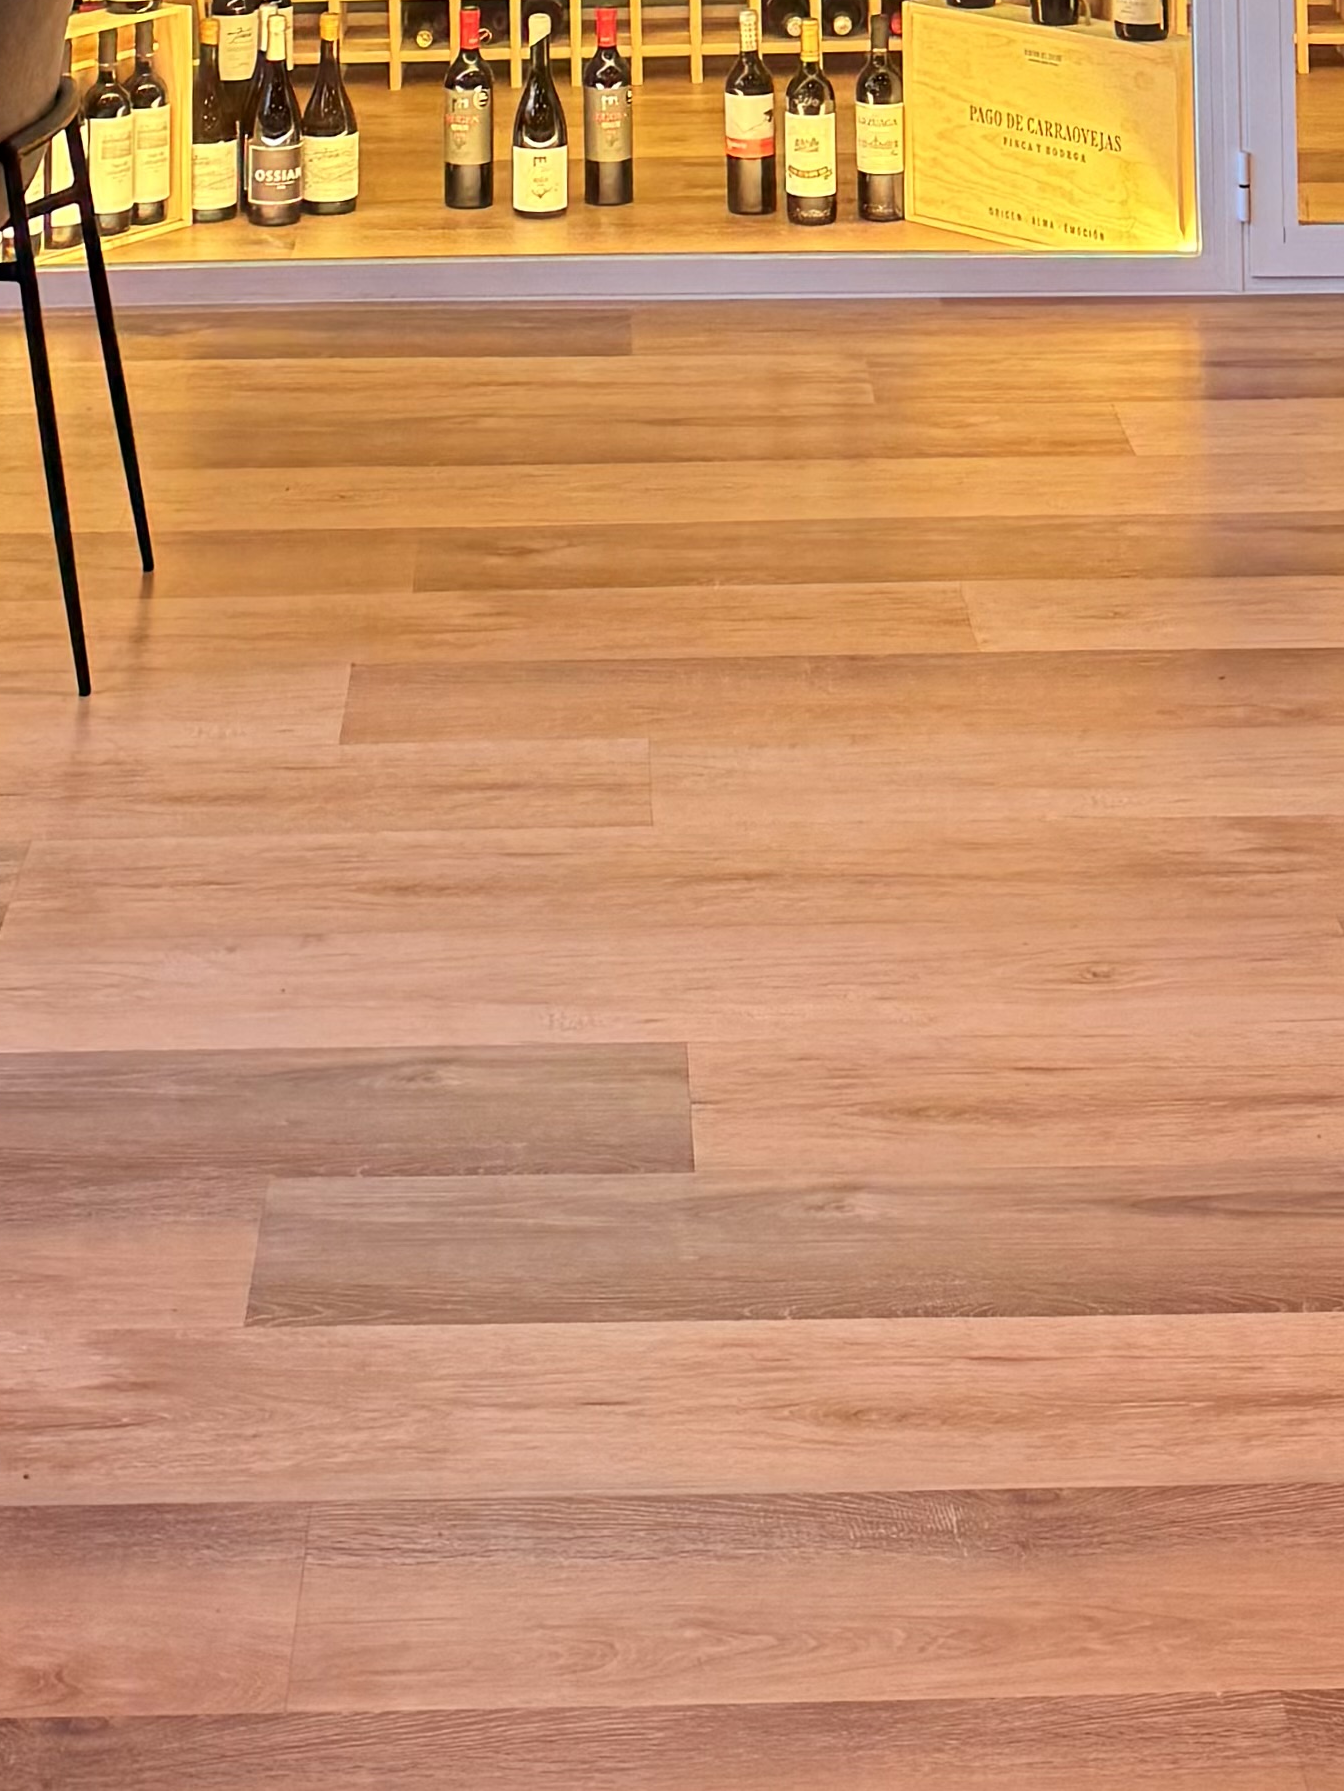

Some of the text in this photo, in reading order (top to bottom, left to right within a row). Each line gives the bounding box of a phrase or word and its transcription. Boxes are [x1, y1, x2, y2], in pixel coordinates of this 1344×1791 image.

[969, 104, 1123, 152] PAGO DE CARRAOVEJAS
[1003, 136, 1087, 164] FINCA Y BODEGA
[988, 206, 1023, 222] ORIGEN
[1031, 215, 1055, 230] ALMA
